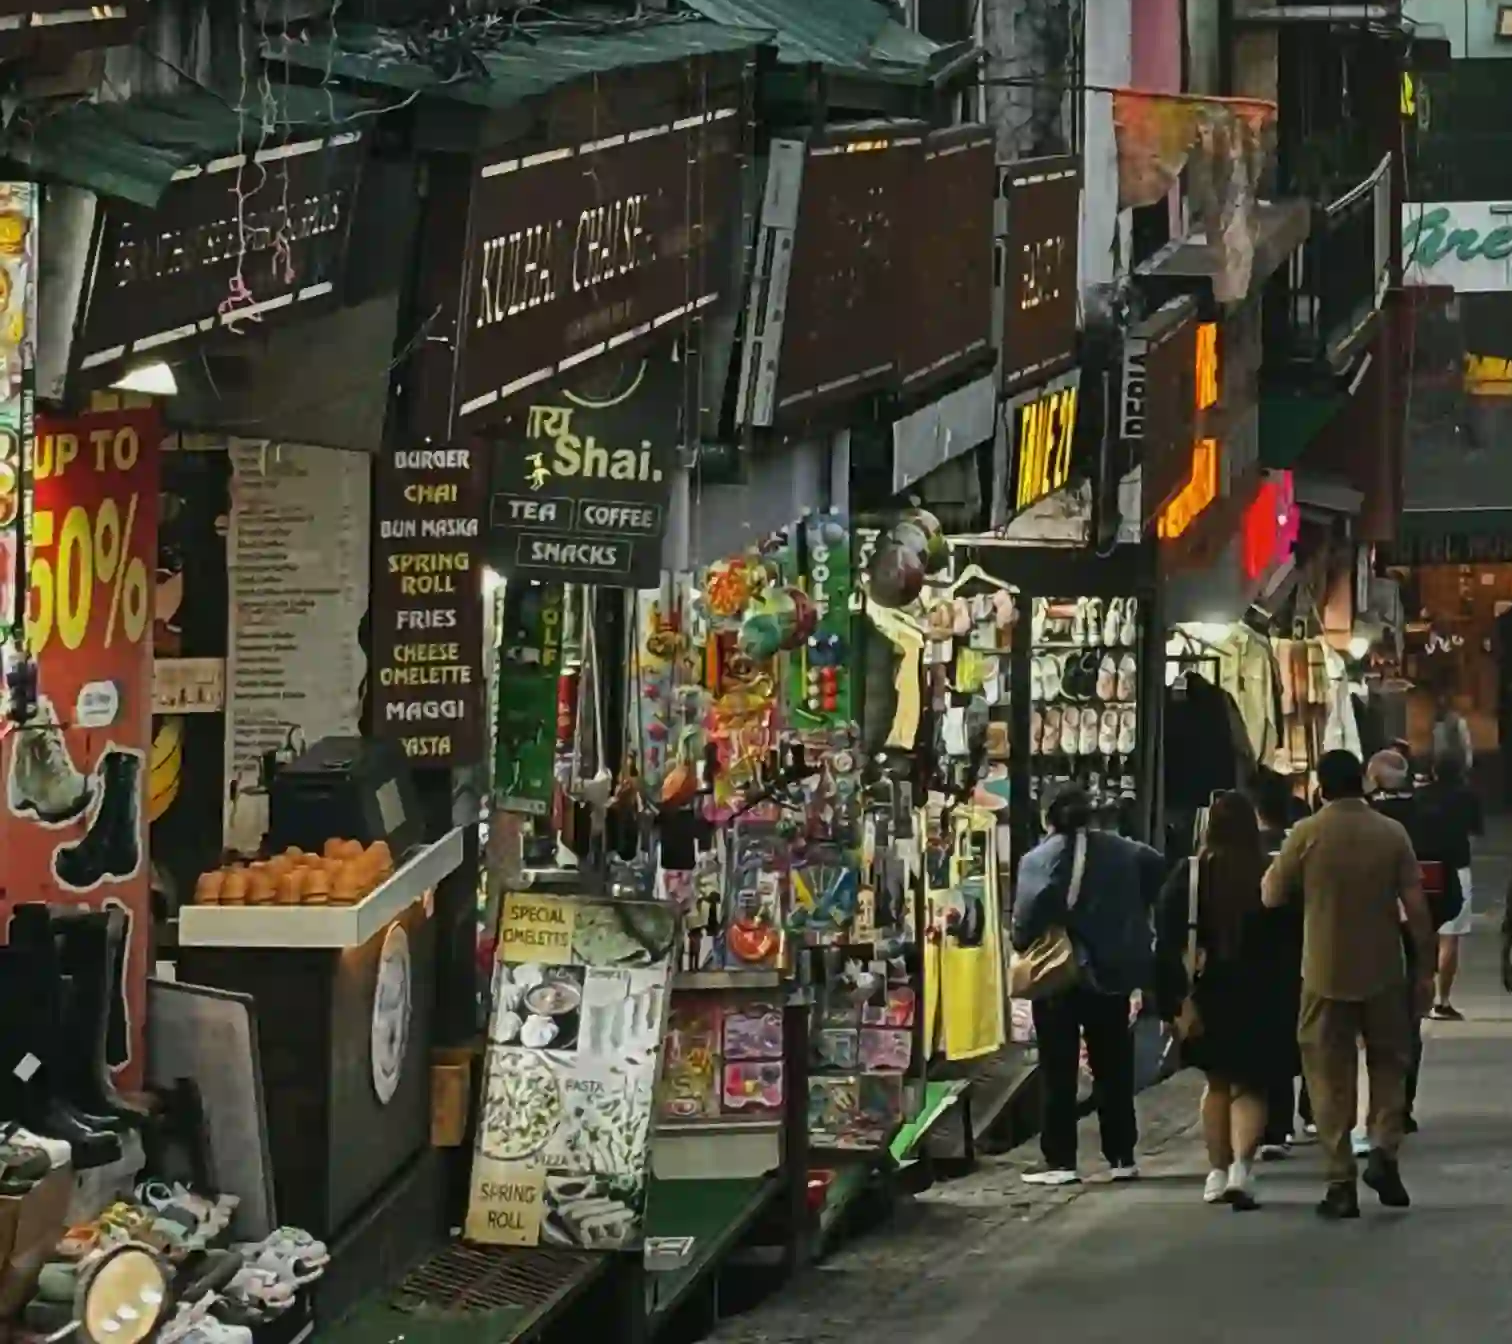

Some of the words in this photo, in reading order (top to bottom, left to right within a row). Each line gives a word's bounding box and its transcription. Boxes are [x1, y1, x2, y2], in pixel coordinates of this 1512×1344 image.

[33, 432, 79, 480] UP
[89, 426, 139, 472] TO
[394, 449, 470, 470] BURGER
[403, 483, 458, 504] CHAI
[507, 499, 558, 522] TEA
[583, 505, 654, 529] COFFEE
[380, 519, 416, 538] BUN
[421, 517, 479, 538] MASKA
[387, 552, 470, 573] SPRING
[530, 541, 618, 566] SNACKS
[24, 491, 148, 653] 50%
[401, 574, 456, 595] ROLL
[395, 609, 458, 631] FRIES
[392, 642, 460, 664] CHEESE
[380, 665, 472, 686] OMELETTE
[385, 699, 466, 721] MAGGI
[509, 905, 566, 924] SPECIAL
[481, 1183, 536, 1205] SPRING
[487, 1209, 525, 1231] ROLL
